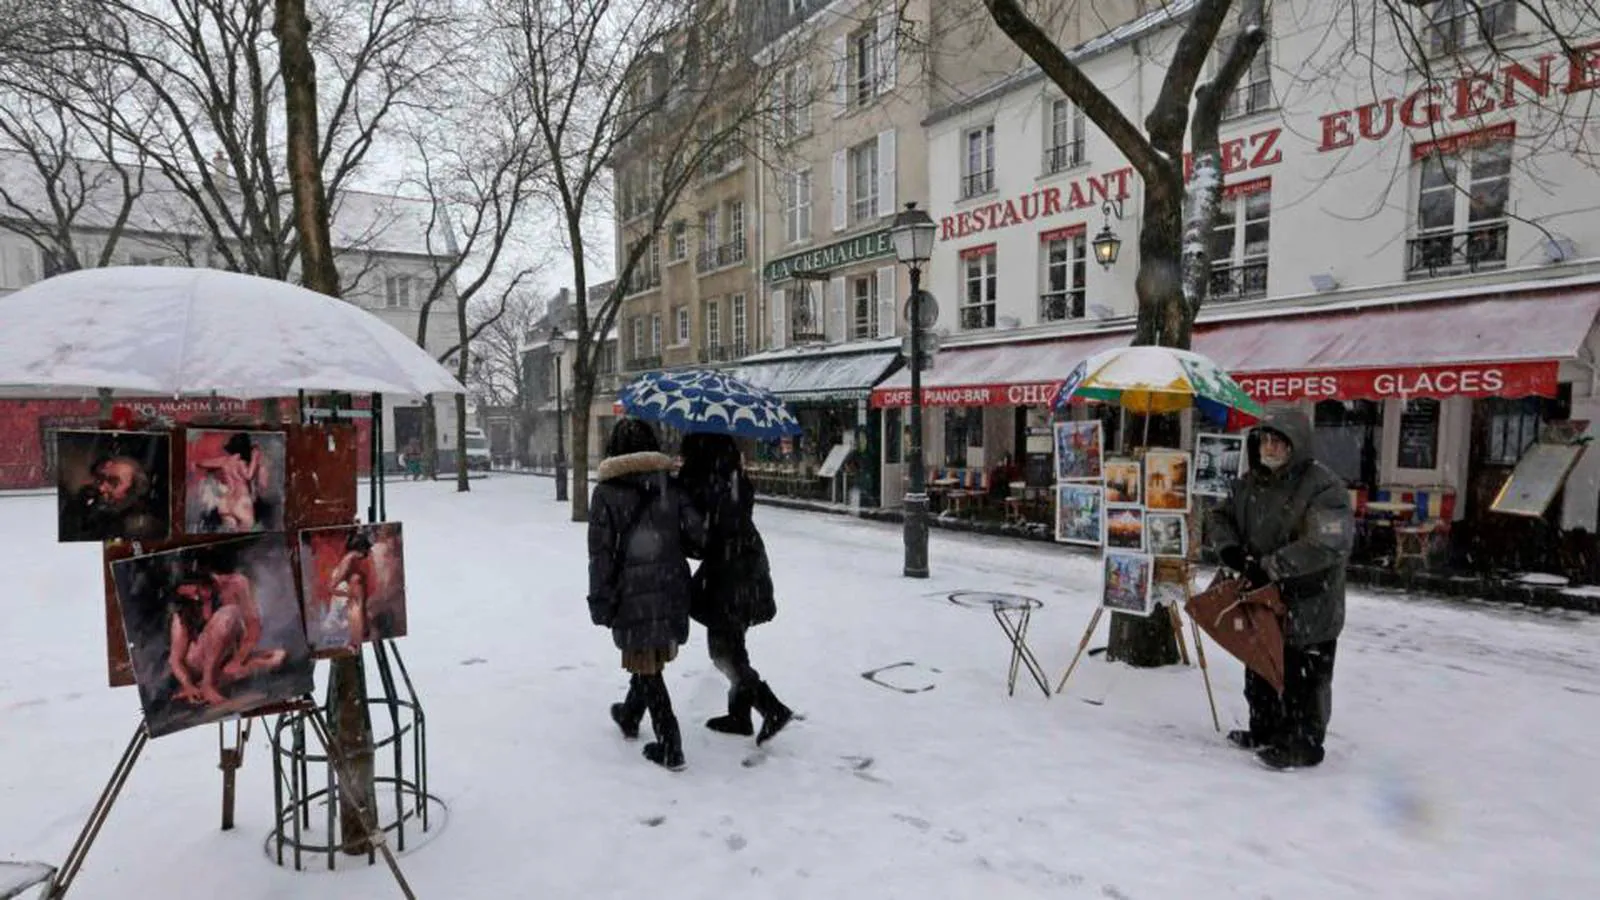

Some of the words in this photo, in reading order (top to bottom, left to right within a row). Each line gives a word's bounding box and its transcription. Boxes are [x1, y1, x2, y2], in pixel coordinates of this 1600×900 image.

[940, 166, 1133, 242] RESTAURANT
[771, 262, 790, 280] LA
[1239, 376, 1337, 397] CREPES
[1374, 369, 1503, 395] GLACES
[924, 390, 990, 404] PIANO-BAR
